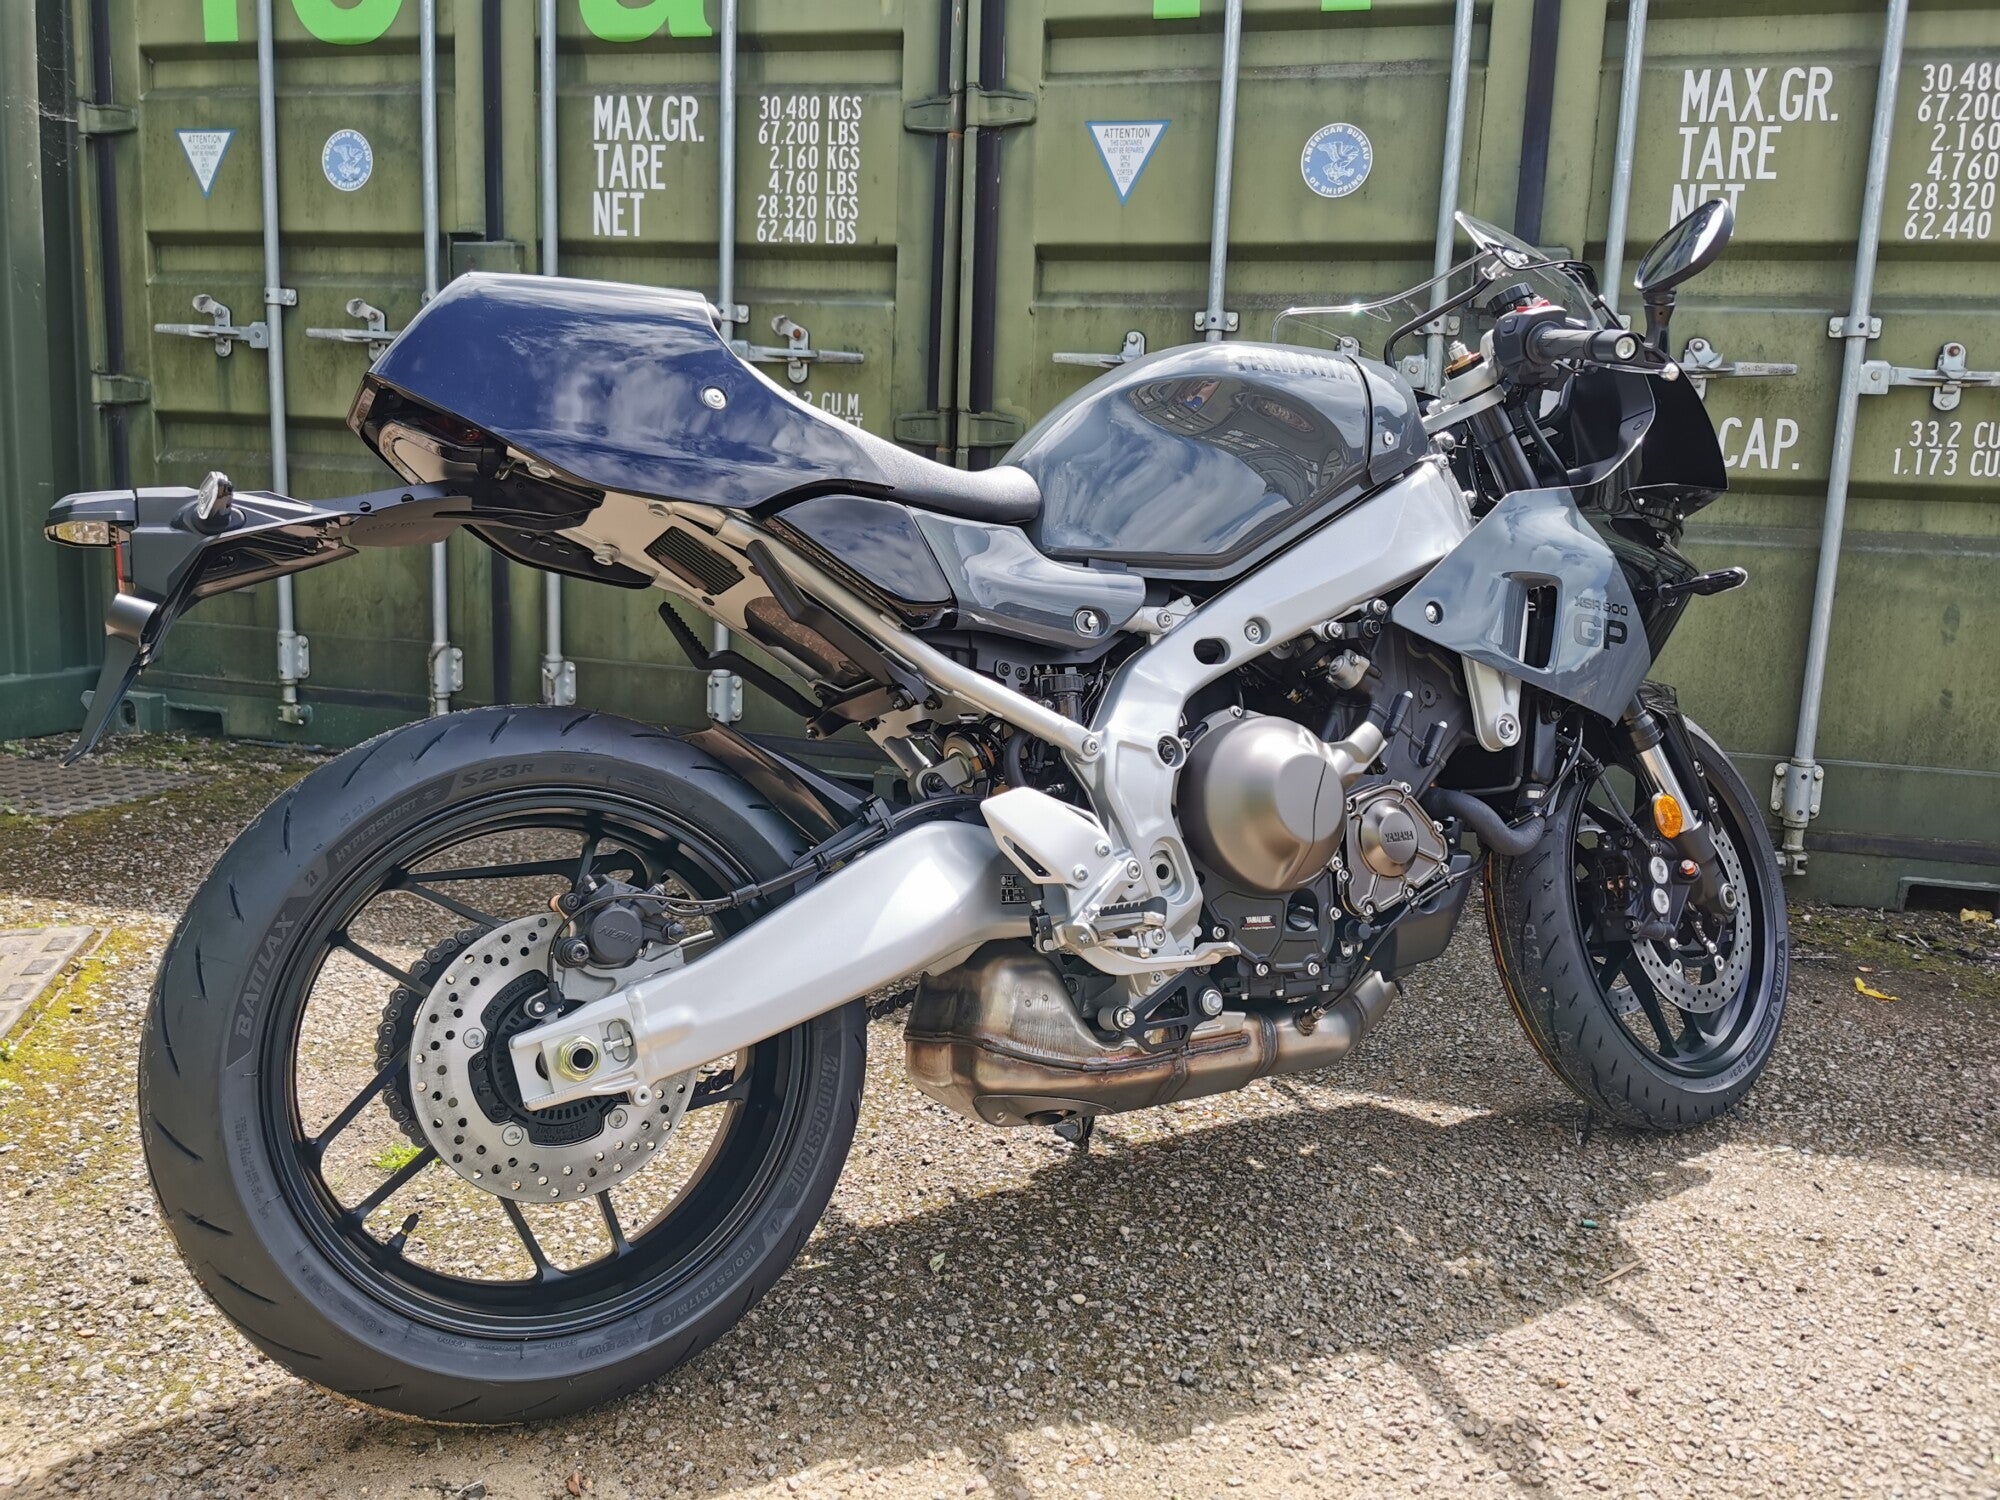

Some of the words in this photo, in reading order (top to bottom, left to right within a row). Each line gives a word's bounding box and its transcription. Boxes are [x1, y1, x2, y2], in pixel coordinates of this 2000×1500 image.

[759, 95, 820, 120] 30,480
[828, 96, 862, 120] KGS
[1680, 66, 1839, 123] MAX.GR.
[1917, 92, 2000, 123] 67,200
[593, 95, 705, 143] MAX.GR.
[758, 120, 820, 145] 67,200
[827, 121, 859, 145] LBS
[1103, 127, 1151, 139] ATTENTION
[188, 134, 222, 144] ATTENTION
[1305, 126, 1343, 163] AMERICAN
[1346, 128, 1370, 160] BUREAU
[1930, 122, 2000, 152] 2,160
[593, 144, 666, 190] TARE
[769, 146, 818, 170] 2,160
[826, 146, 860, 170] KGS
[1678, 126, 1782, 180] TARE
[1927, 152, 1999, 182] 4,760
[768, 170, 818, 195] 4,760
[826, 171, 857, 195] LBS
[1309, 176, 1320, 187] OF
[1320, 174, 1364, 194] SHIPPING
[1906, 181, 1996, 211] 28,320
[593, 191, 645, 237] NET
[757, 195, 818, 220] 28,320
[825, 196, 859, 220] KGS
[756, 219, 817, 244] 62,440
[825, 220, 856, 244] LBS
[1903, 211, 1992, 240] 62,440
[821, 391, 864, 417] CU.M.
[1718, 416, 1800, 470] CAP.
[1908, 420, 1962, 448] 33.2
[1892, 447, 1958, 476] 1,173
[1573, 613, 1628, 651] GP
[461, 763, 535, 789] S23R
[1384, 830, 1414, 843] YAMAHA
[234, 912, 295, 1038] BATTLAX
